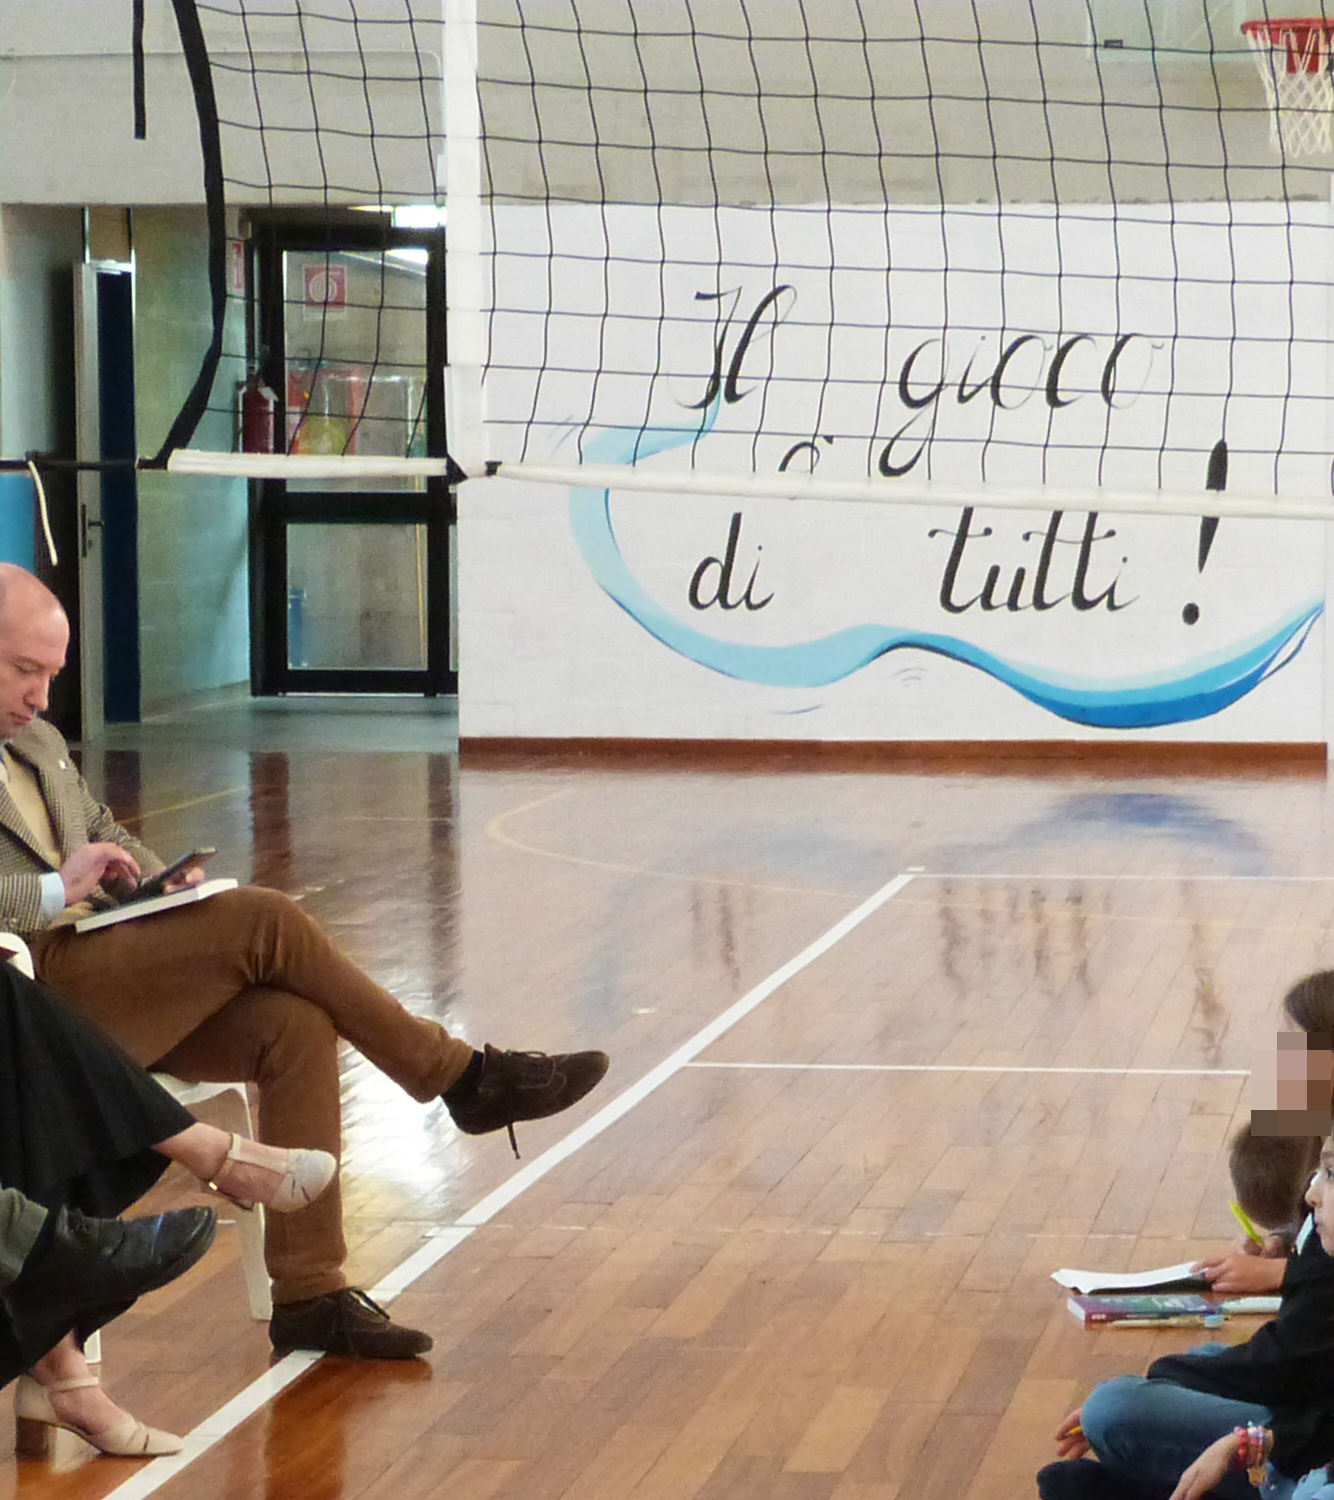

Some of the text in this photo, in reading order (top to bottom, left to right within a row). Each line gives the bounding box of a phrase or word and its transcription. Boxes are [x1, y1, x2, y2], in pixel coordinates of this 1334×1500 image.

[668, 284, 1165, 477] Il gioco
[688, 511, 775, 611] di
